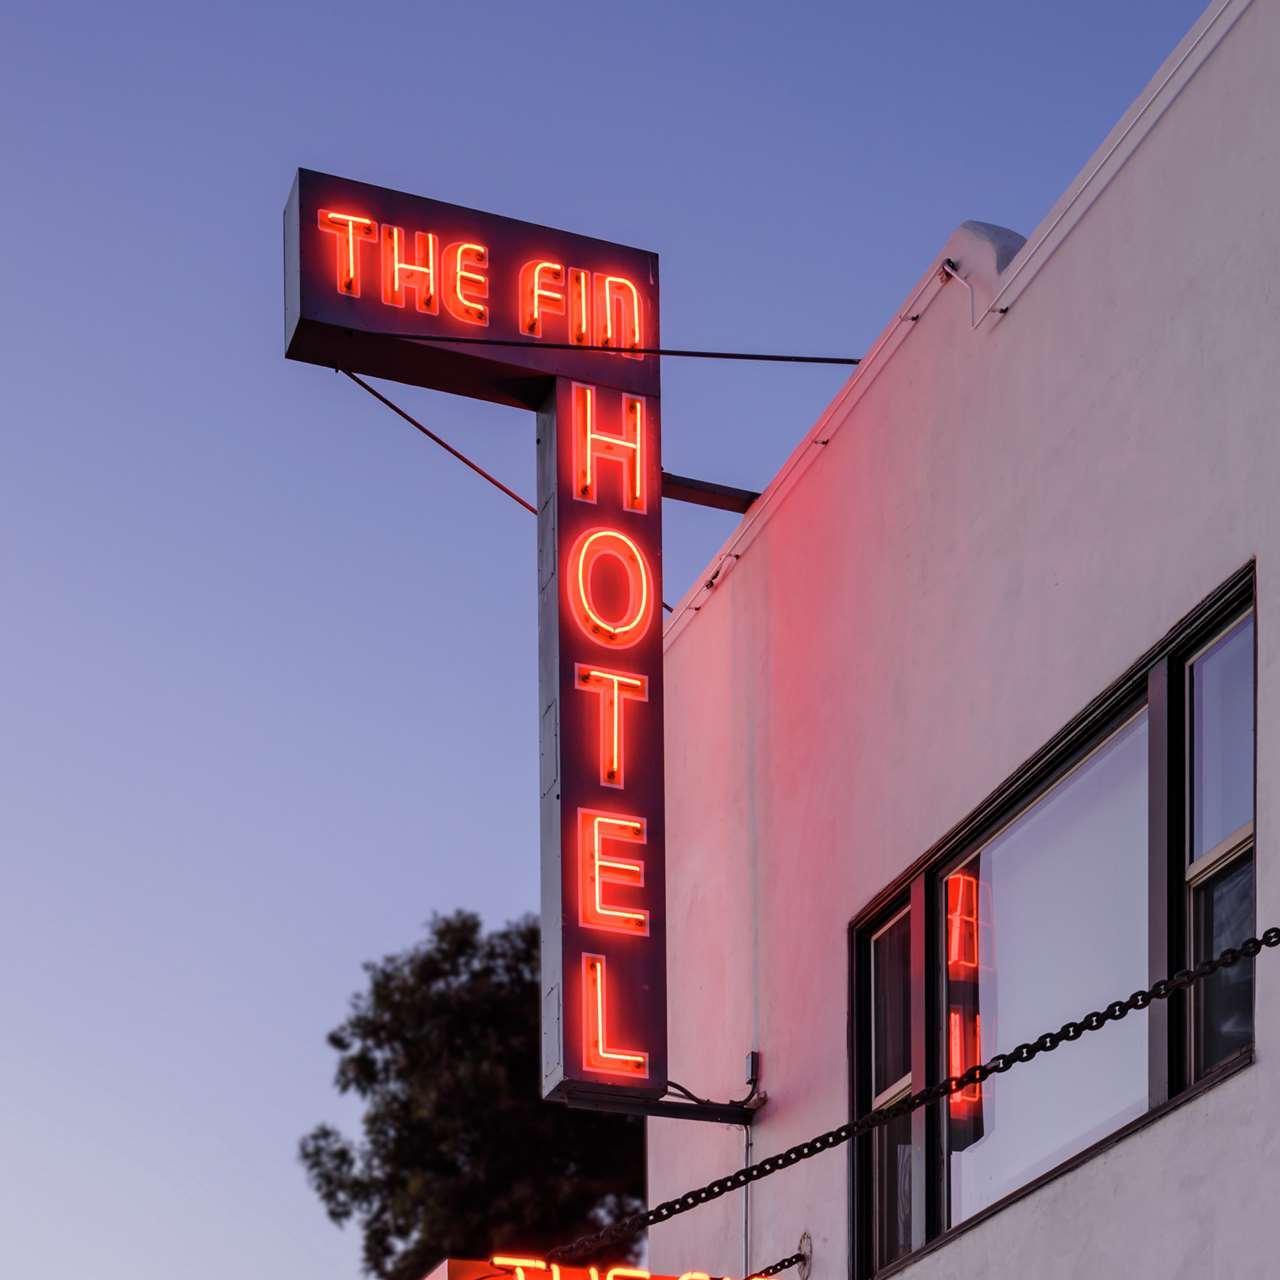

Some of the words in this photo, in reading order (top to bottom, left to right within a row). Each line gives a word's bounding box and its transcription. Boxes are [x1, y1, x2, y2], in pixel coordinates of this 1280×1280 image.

[317, 208, 489, 327] THE
[519, 259, 645, 360] FIN
[566, 381, 655, 1080] HOTEL
